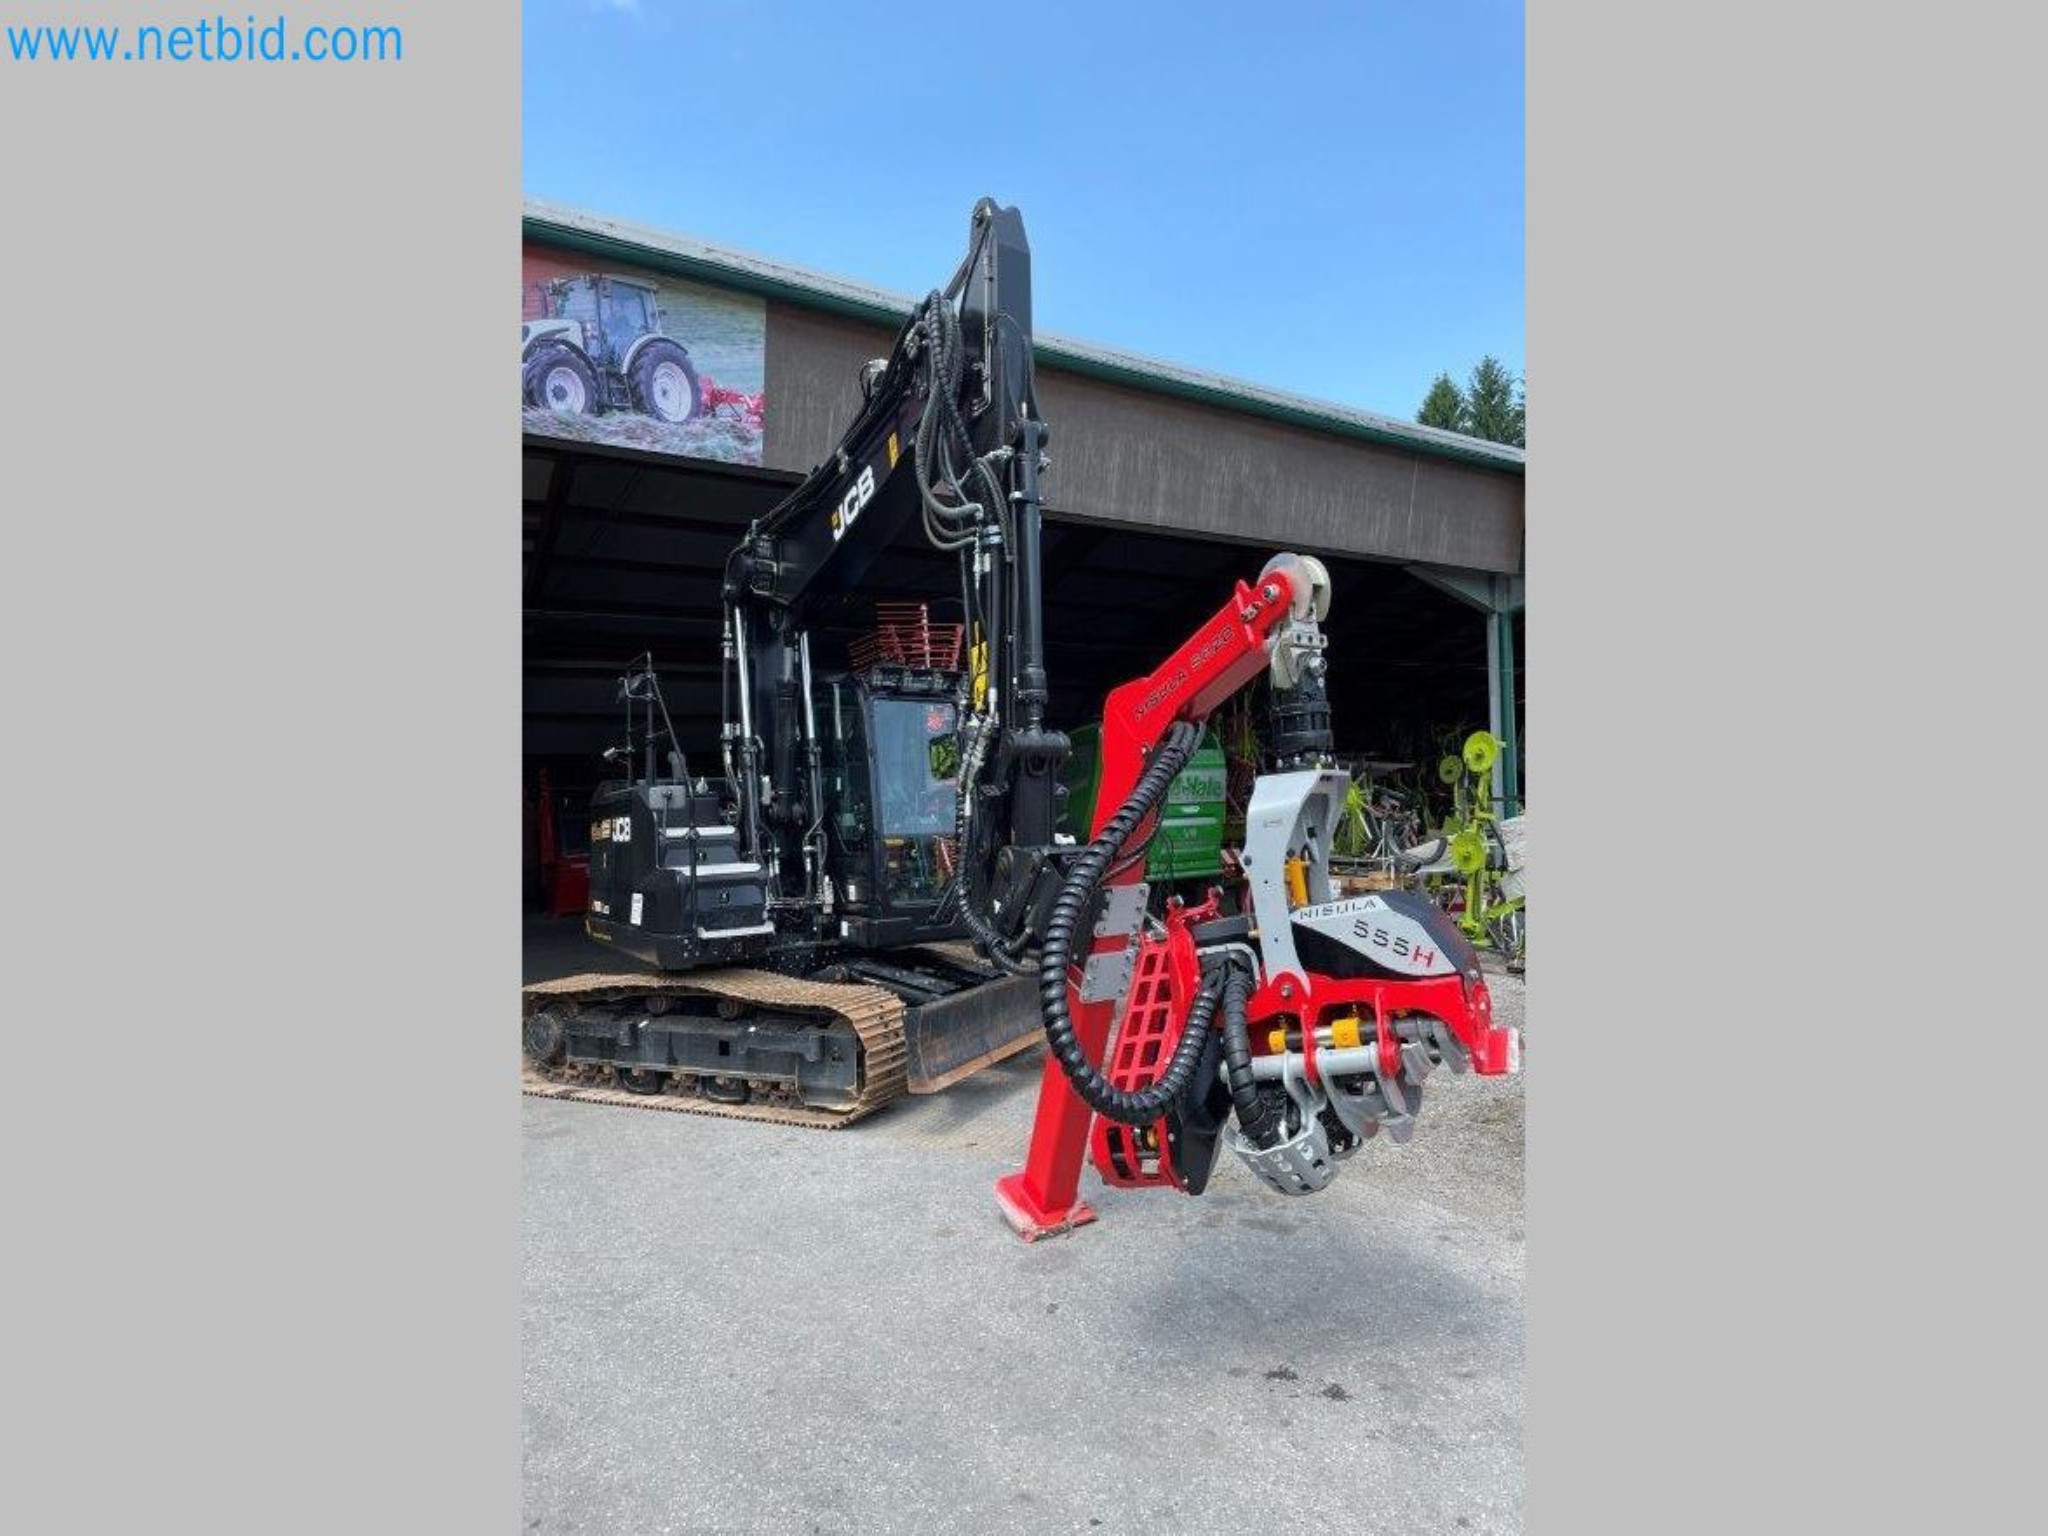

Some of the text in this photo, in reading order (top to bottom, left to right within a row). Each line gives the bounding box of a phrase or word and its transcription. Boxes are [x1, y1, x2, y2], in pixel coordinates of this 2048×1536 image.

[832, 464, 875, 542] JCB
[1300, 899, 1377, 920] NISULA
[1353, 918, 1435, 968] 555H
